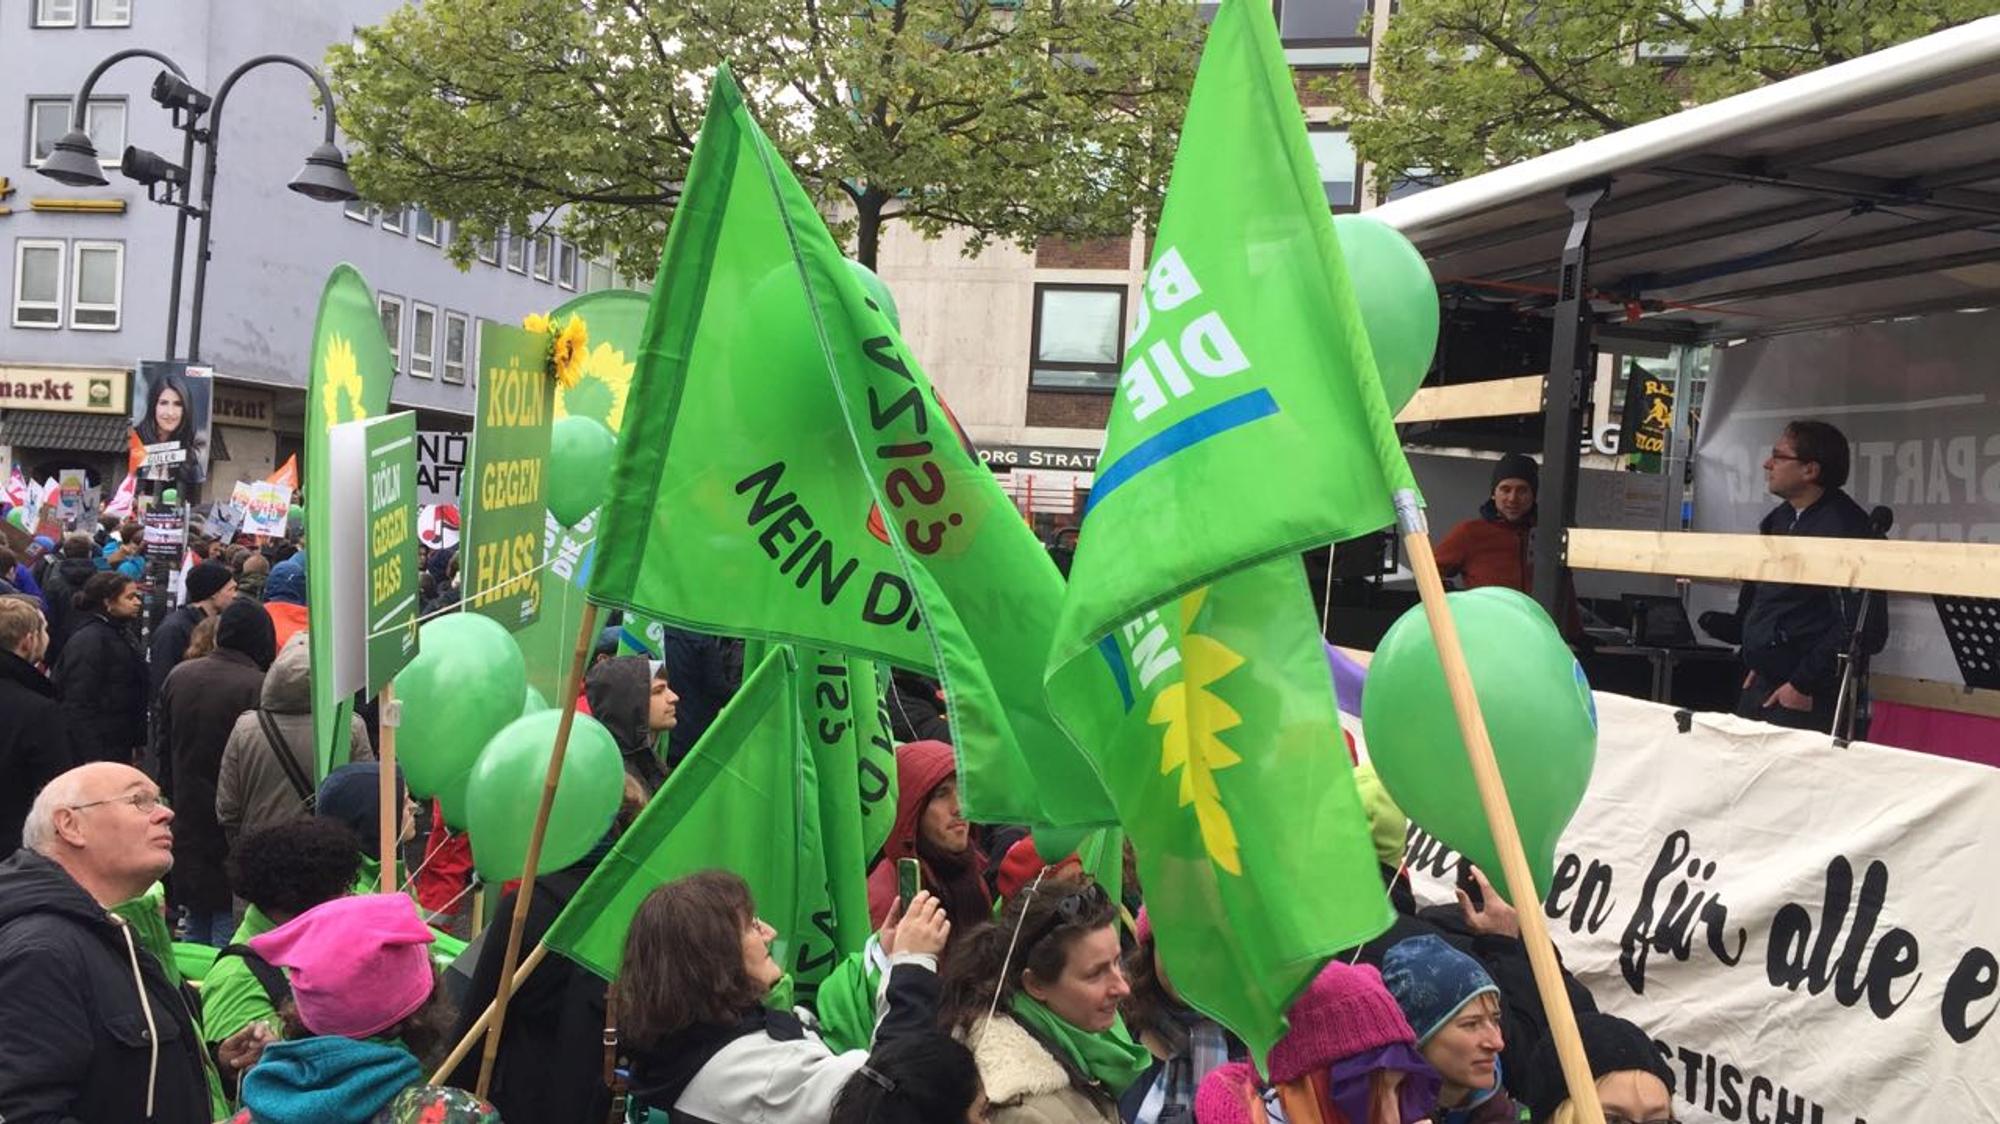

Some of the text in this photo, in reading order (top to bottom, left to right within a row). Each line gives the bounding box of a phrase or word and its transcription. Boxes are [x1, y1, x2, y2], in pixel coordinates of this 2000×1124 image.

[487, 356, 546, 427] KÖLN
[481, 458, 542, 511] GEGEN
[1029, 451, 1099, 468] STRAT
[372, 461, 401, 512] KÖLN
[372, 505, 409, 558] GEGEN
[735, 461, 860, 606] NEIN
[373, 554, 402, 607] HASS
[475, 532, 537, 608] HASS
[1620, 829, 1747, 995] für
[1766, 855, 1922, 1019] alle
